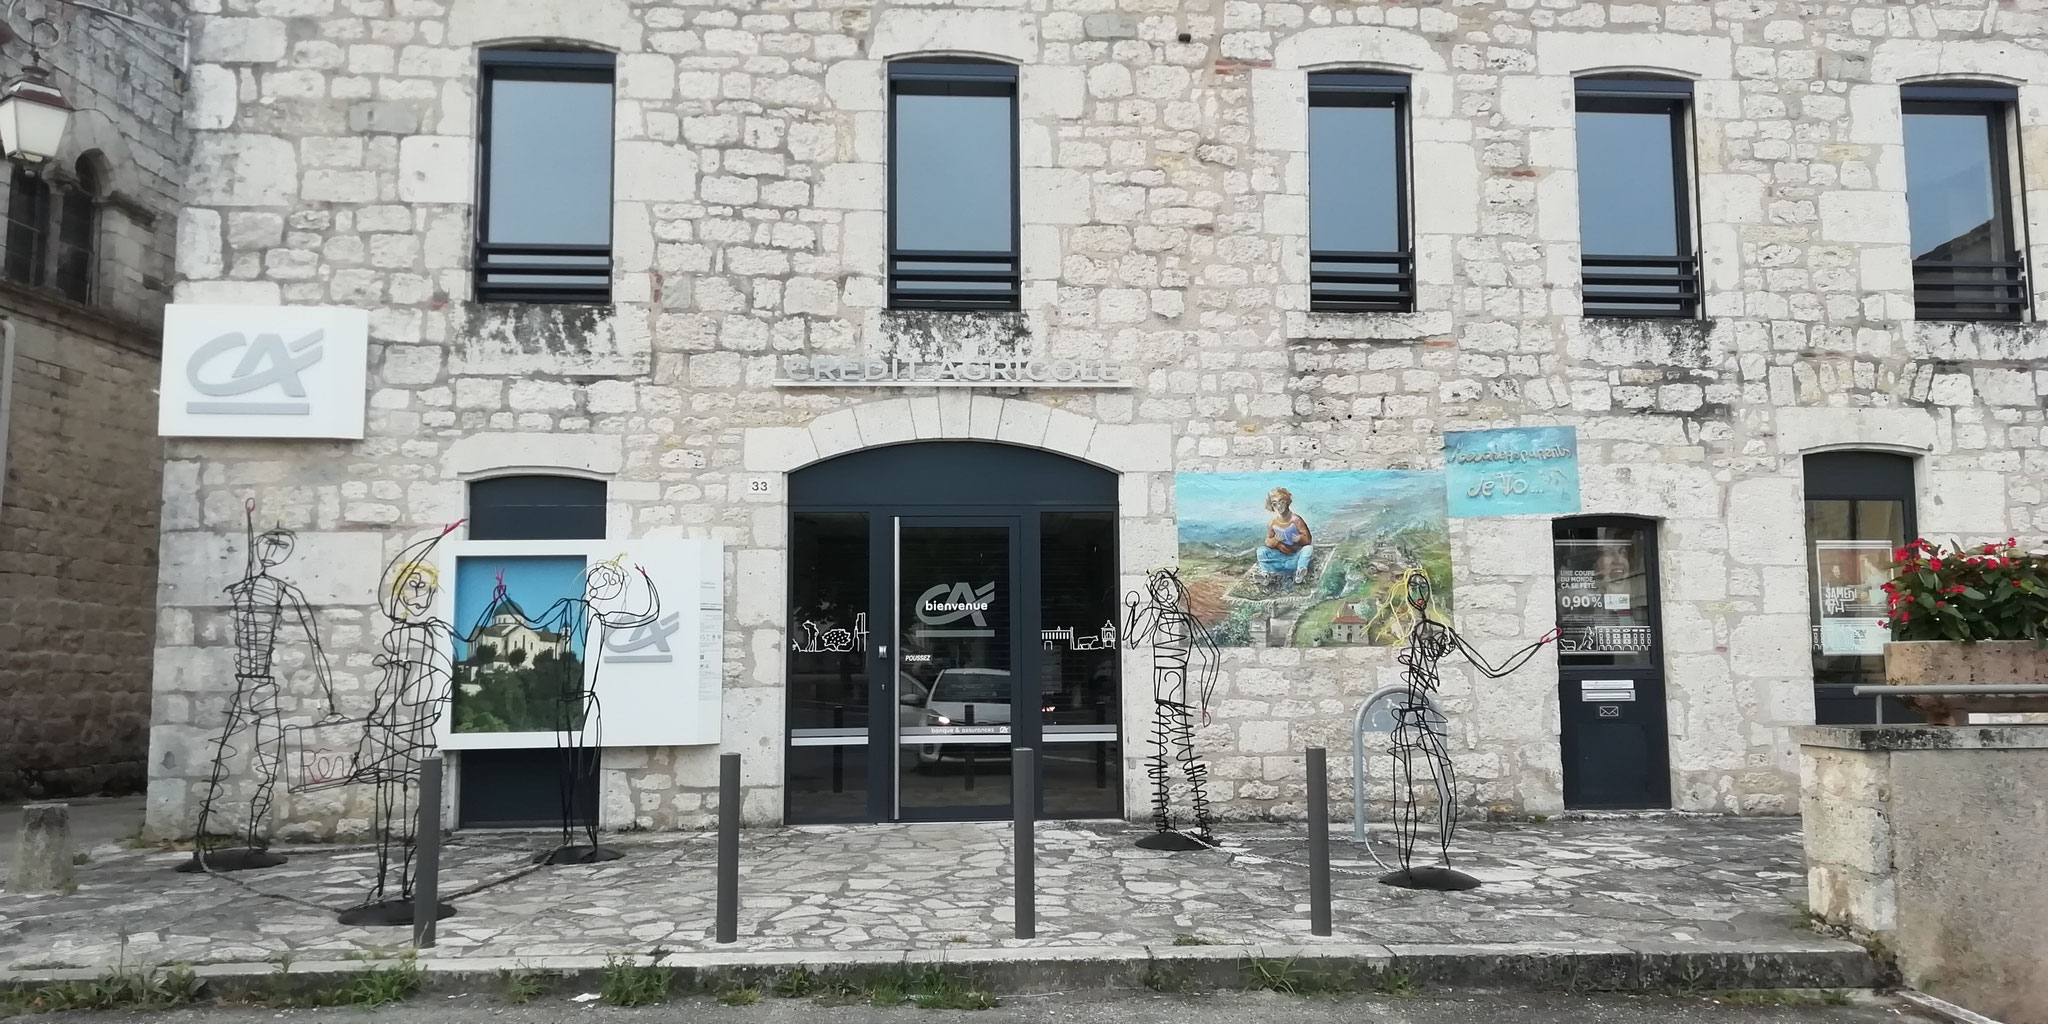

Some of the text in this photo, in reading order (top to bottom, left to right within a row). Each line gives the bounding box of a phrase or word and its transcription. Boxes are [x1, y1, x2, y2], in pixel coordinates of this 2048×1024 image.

[783, 357, 1121, 382] CREDIT AGRICOLE
[751, 481, 768, 492] 33
[924, 600, 989, 612] bienvenue
[904, 654, 932, 662] POUSSEZ
[931, 727, 954, 735] banque
[961, 726, 995, 734] assurances
